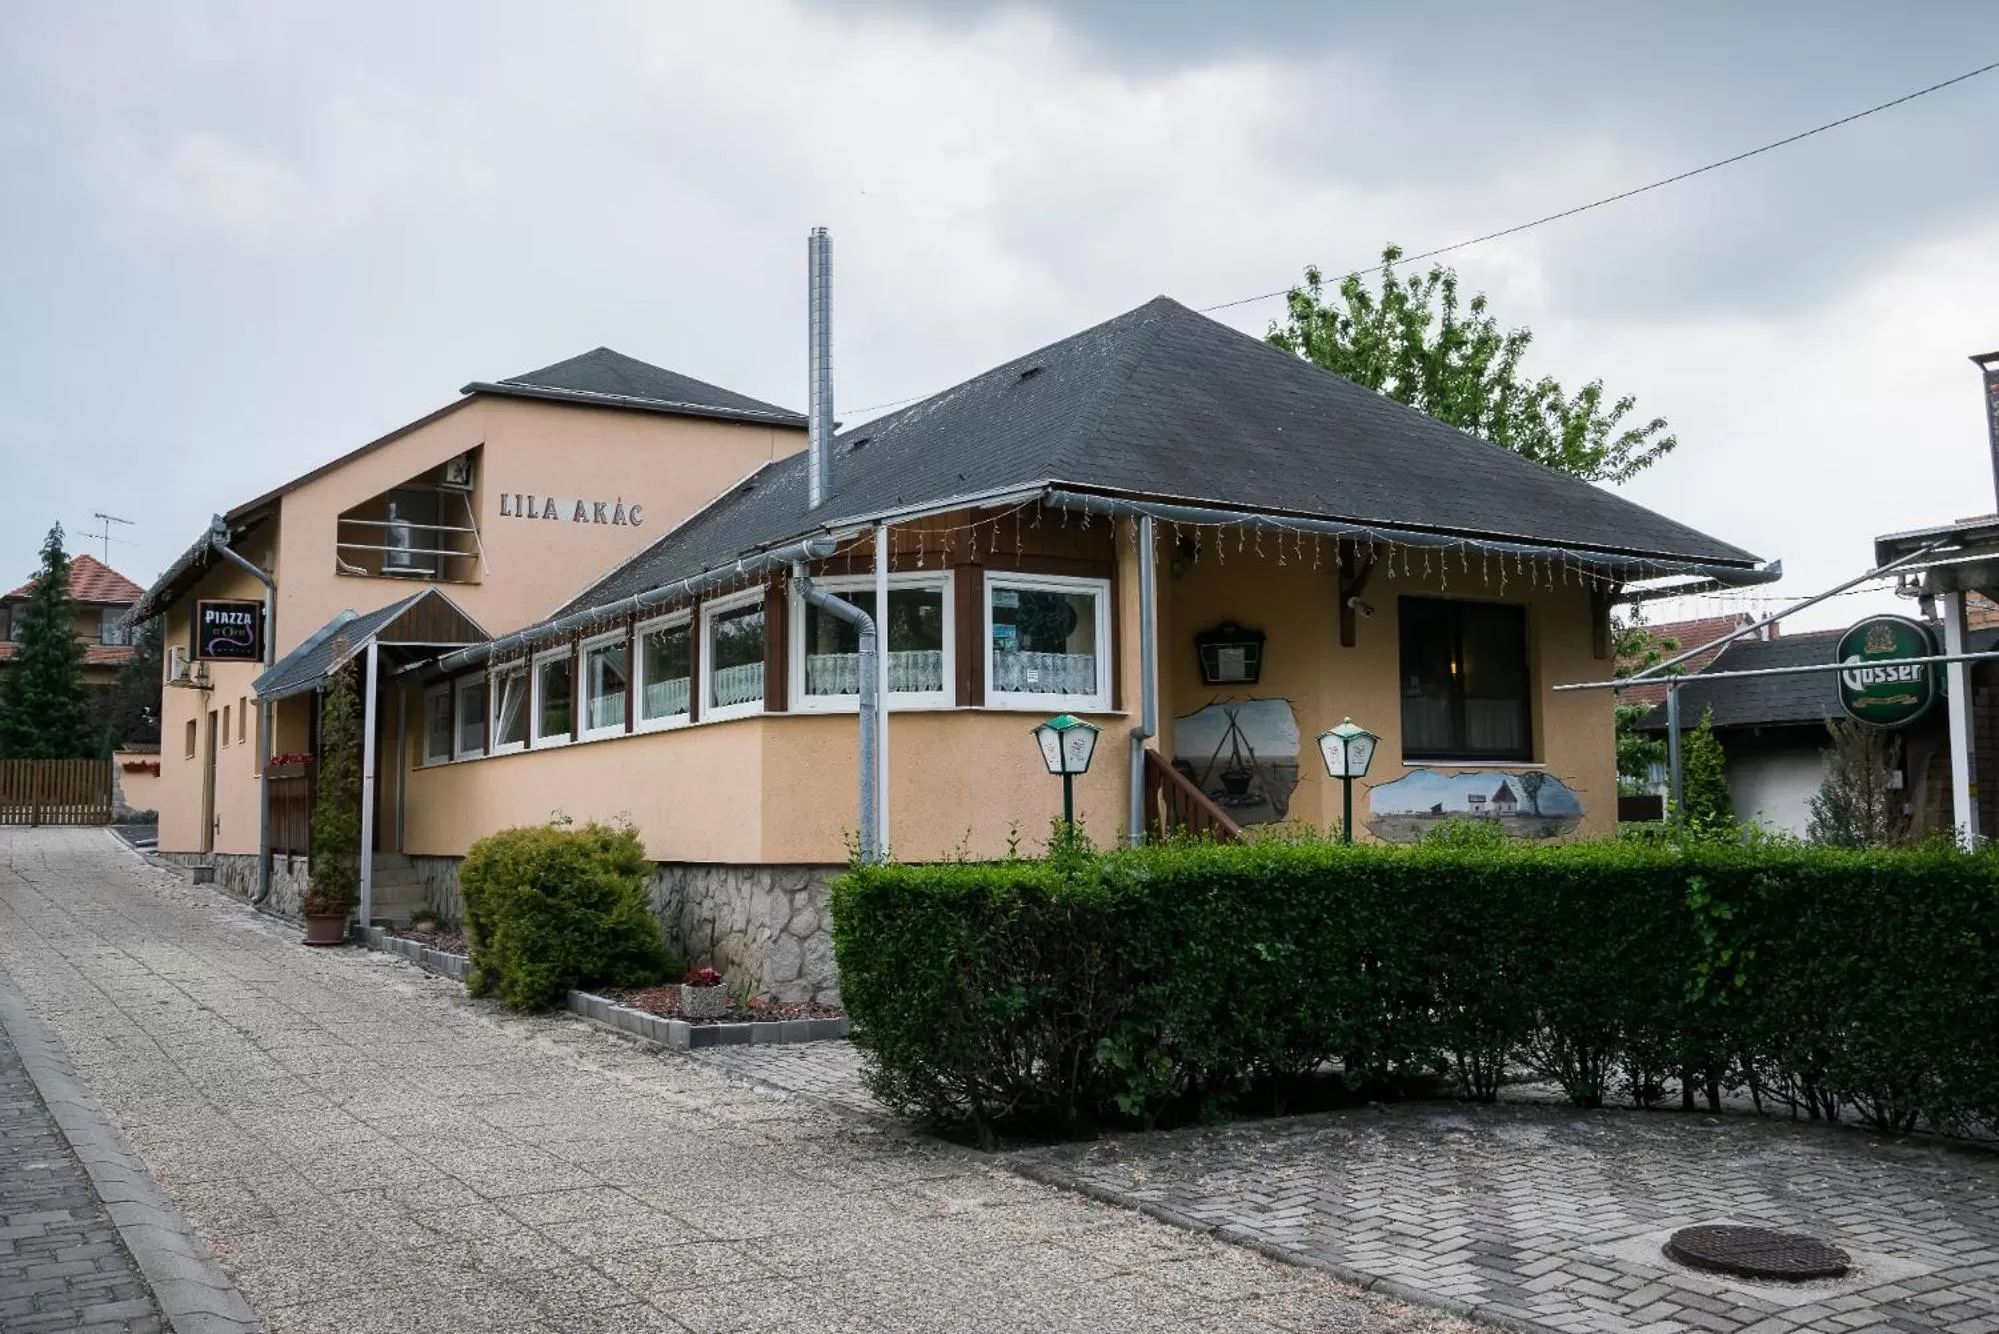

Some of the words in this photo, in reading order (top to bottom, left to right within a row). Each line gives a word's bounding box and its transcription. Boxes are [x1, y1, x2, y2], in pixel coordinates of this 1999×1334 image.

[499, 493, 558, 520] LILA
[573, 496, 643, 527] AKÁC
[205, 610, 252, 624] PIAZZA
